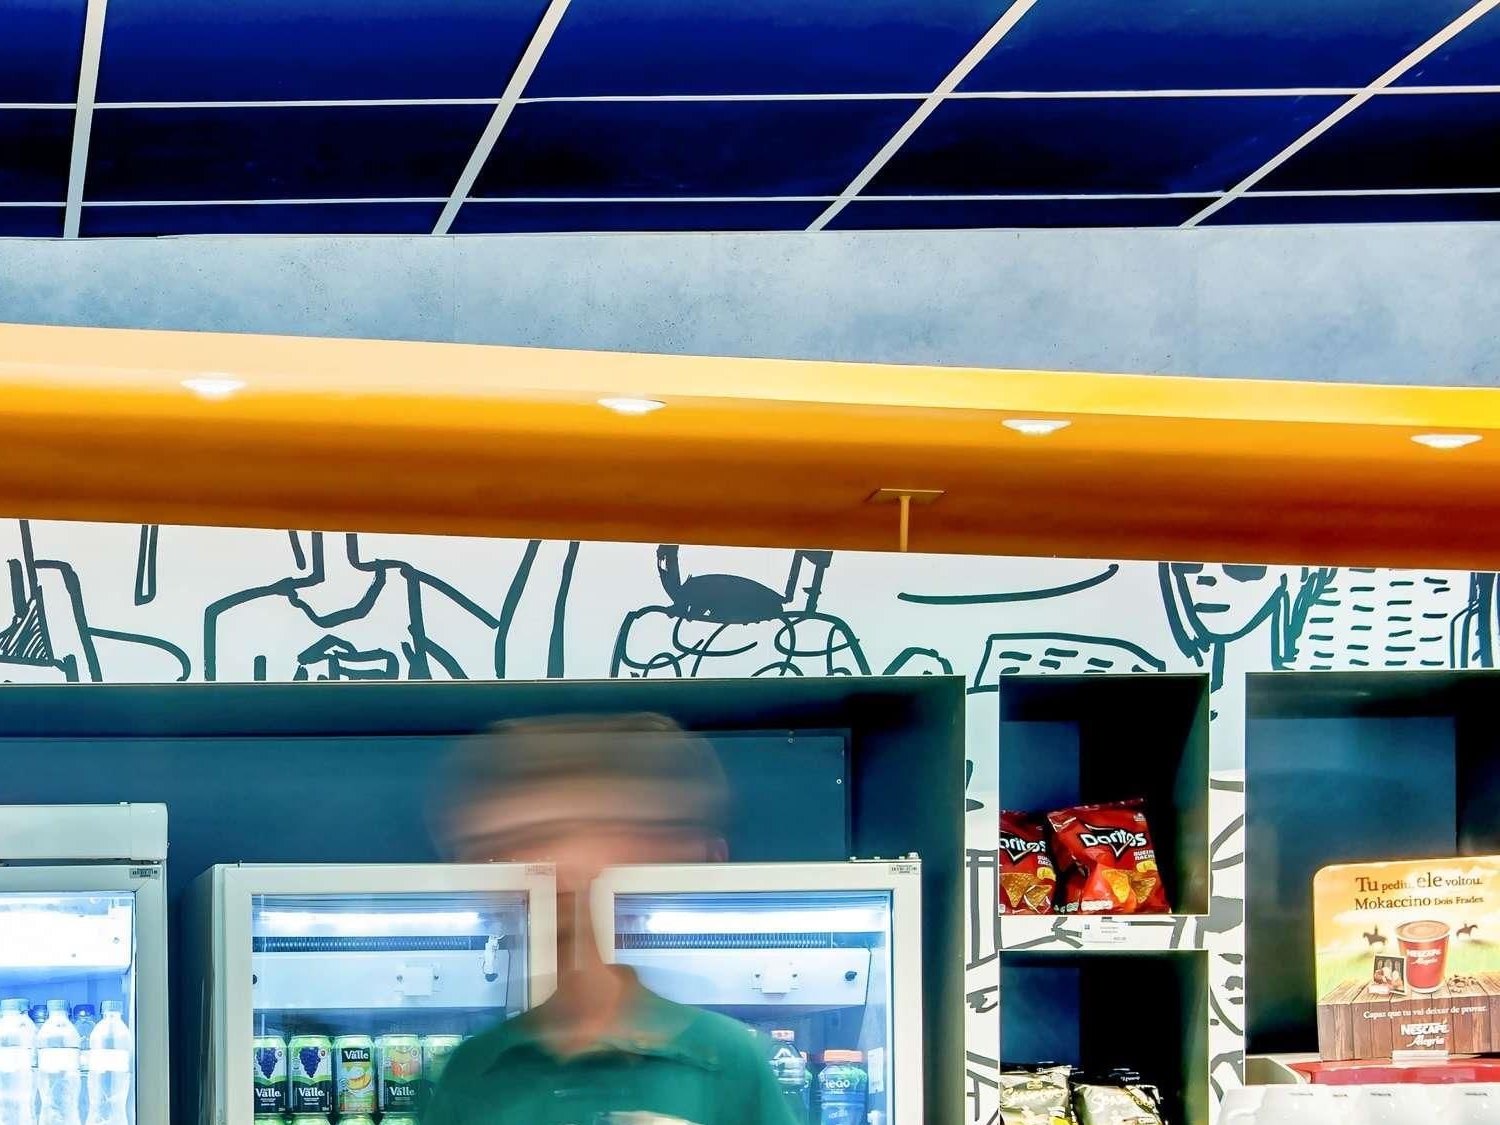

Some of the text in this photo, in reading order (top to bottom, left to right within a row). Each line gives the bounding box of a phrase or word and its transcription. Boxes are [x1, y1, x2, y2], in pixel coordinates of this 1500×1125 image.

[999, 836, 1046, 854] oritos
[1080, 829, 1148, 848] Doritos
[1356, 877, 1378, 892] Tu
[1417, 872, 1442, 888] ele
[1355, 896, 1431, 910] Mokaccino
[1388, 1010, 1401, 1019] que
[1426, 1007, 1449, 1015] deixar
[1406, 1035, 1445, 1047] Alegria
